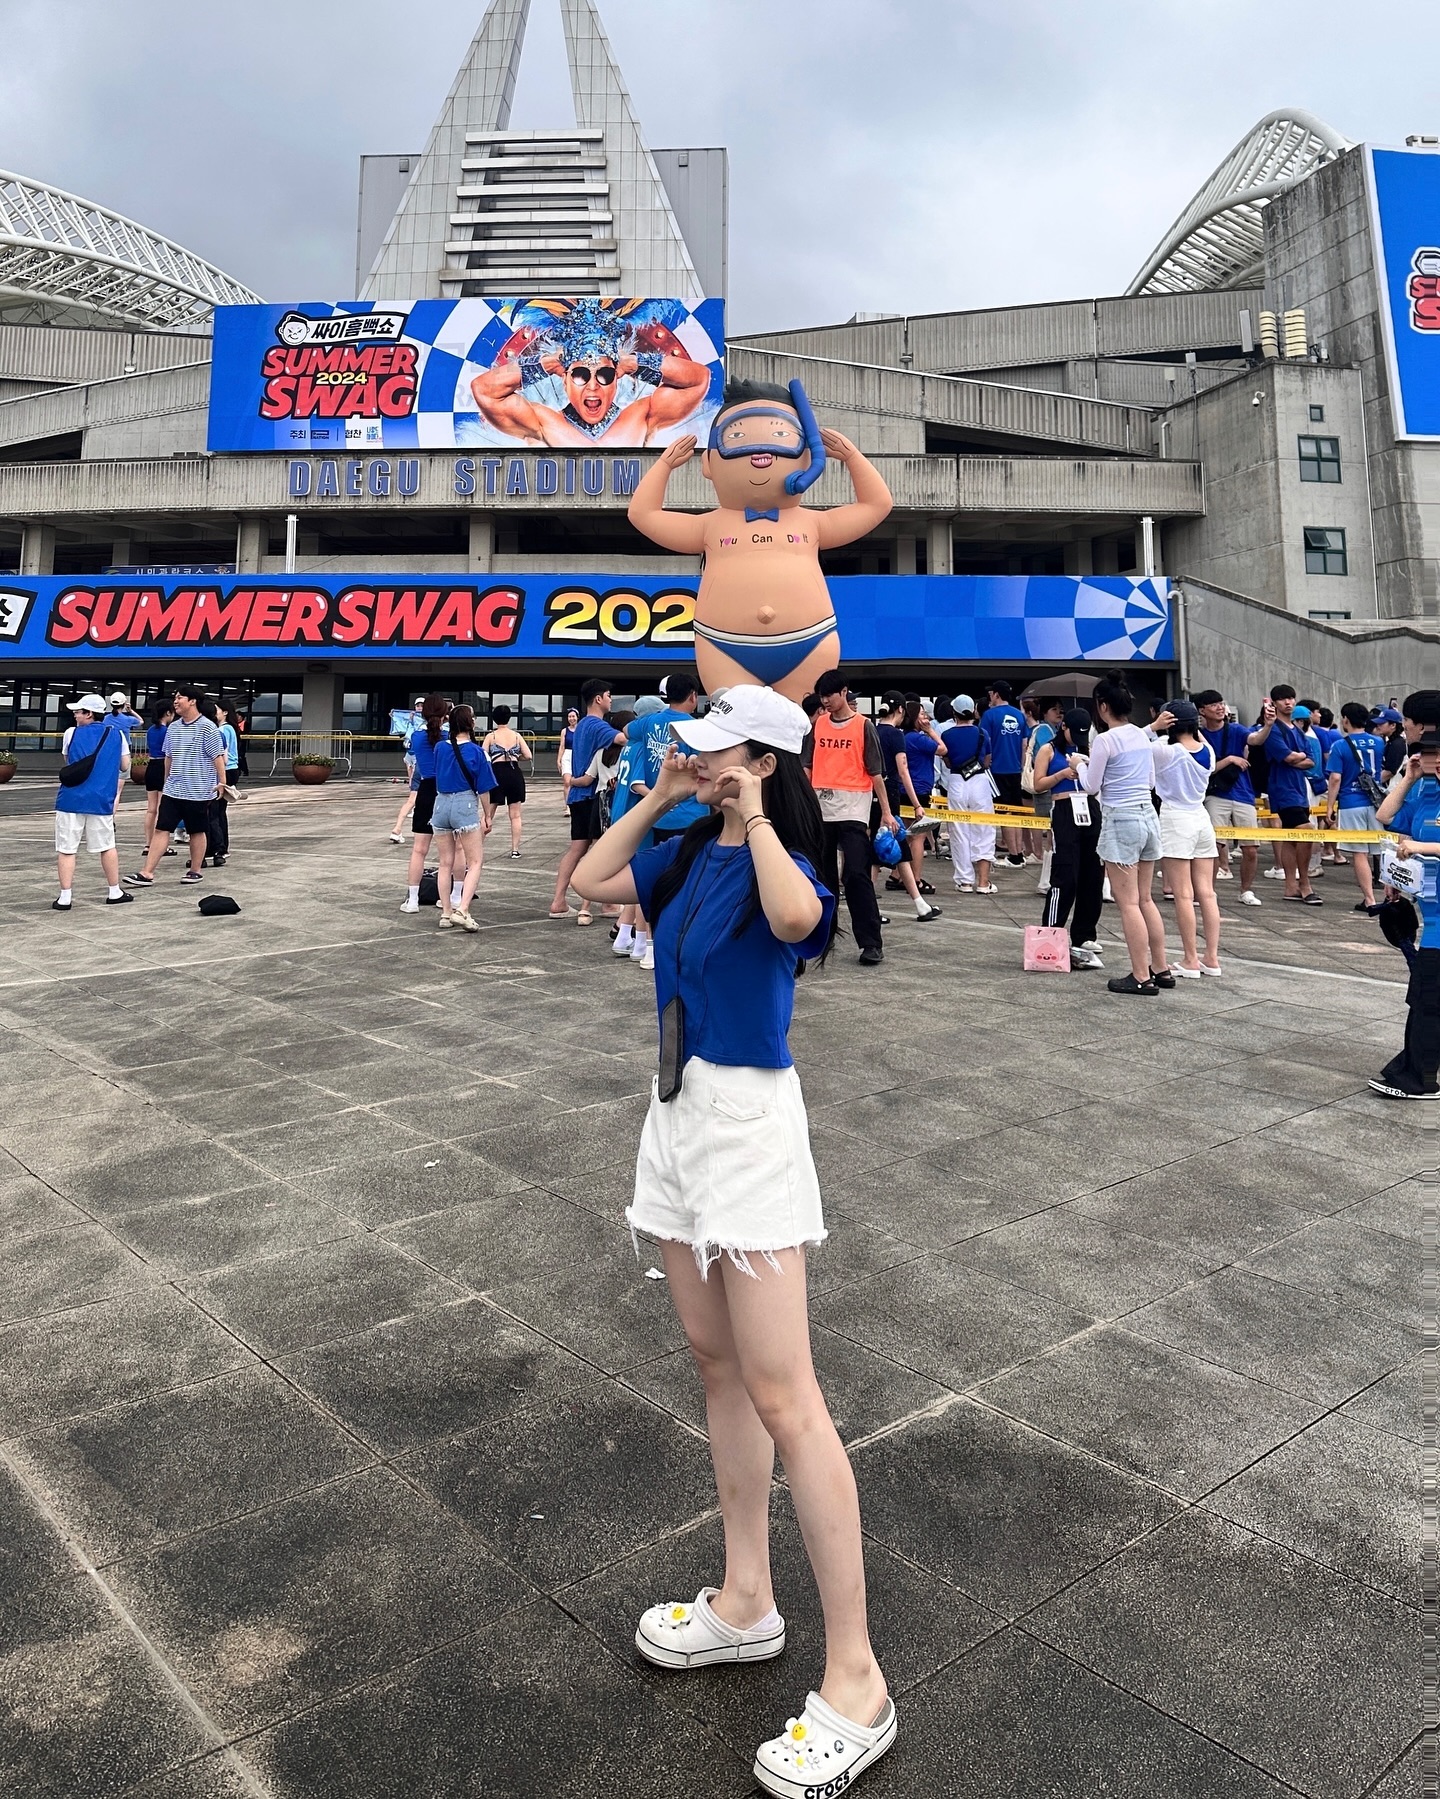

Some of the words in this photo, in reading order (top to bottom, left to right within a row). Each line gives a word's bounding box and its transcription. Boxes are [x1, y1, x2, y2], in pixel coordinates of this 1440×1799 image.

[311, 318, 395, 339] 싸이흠뻑쇼
[263, 347, 416, 376] SUMMER
[316, 372, 367, 385] 2024
[261, 375, 415, 418] SWAG
[288, 459, 420, 496] DAEGU
[454, 457, 641, 496] STADIUM
[752, 534, 773, 543] Can
[51, 591, 329, 642] SUMMER
[332, 591, 519, 641] SWAG
[548, 592, 697, 642] 202
[819, 738, 852, 749] STAFF
[804, 1771, 850, 1799] crocs
